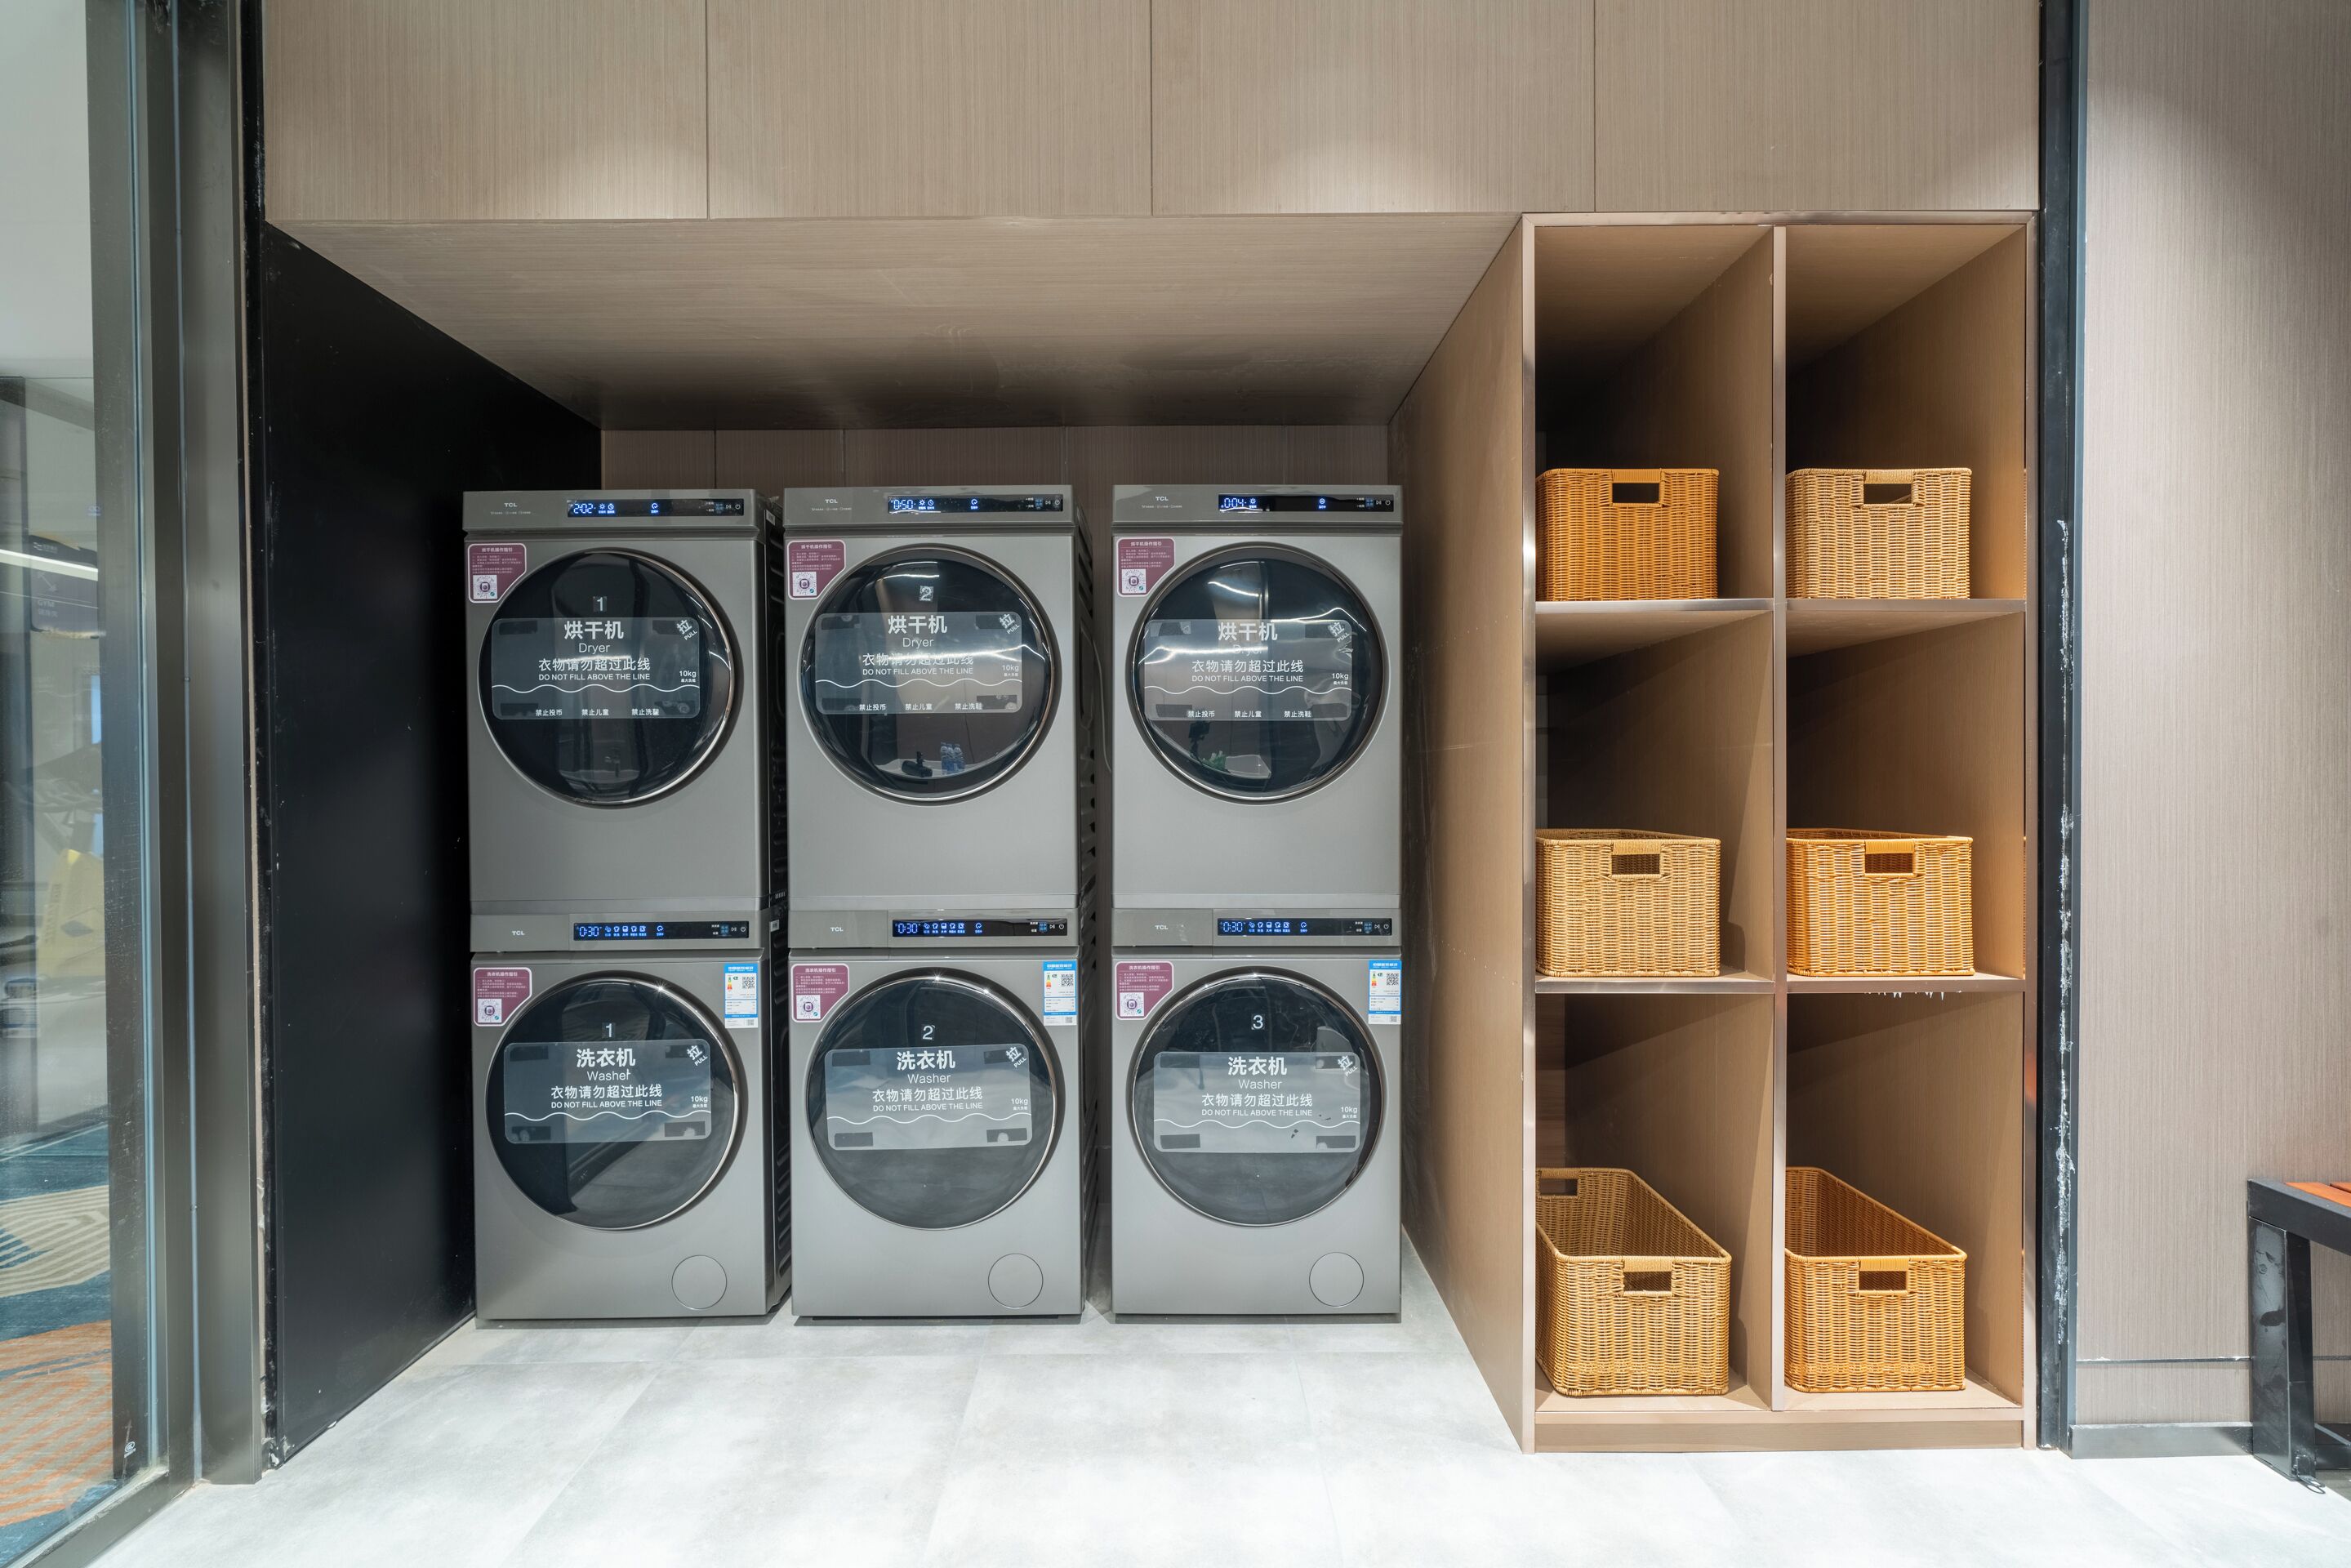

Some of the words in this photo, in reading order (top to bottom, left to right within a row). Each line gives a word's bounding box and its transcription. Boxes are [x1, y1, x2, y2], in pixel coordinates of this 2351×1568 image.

[921, 587, 933, 601] 2
[596, 598, 604, 611] 1
[676, 620, 692, 635] 拉
[888, 615, 948, 635] 烘干机
[999, 614, 1015, 628] 拉
[564, 621, 624, 640] 烘干机
[684, 630, 698, 641] PULL
[1006, 624, 1020, 634] PULL
[1218, 622, 1278, 641] 烘干机
[1329, 622, 1345, 637] 拉
[903, 638, 934, 649] Dryer
[1337, 632, 1350, 643] PULL
[579, 643, 610, 655] Dryer
[539, 657, 650, 671] 衣物请勿超过此线
[1192, 660, 1304, 673] 衣物请勿超过此线
[536, 708, 562, 717] 禁止投币
[1253, 1015, 1264, 1030] 3
[605, 1023, 613, 1038] 1
[922, 1025, 933, 1040] 2
[576, 1048, 636, 1068] 洗衣机
[687, 1045, 703, 1060] 拉
[1005, 1047, 1022, 1062] 拉
[694, 1055, 708, 1067] PULL
[896, 1050, 956, 1071] 洗衣机
[1013, 1056, 1027, 1068] PULL
[1227, 1056, 1287, 1076] 洗衣机
[1338, 1055, 1354, 1070] 拉
[1345, 1065, 1358, 1076] PULL
[907, 1074, 951, 1084] Washer
[1238, 1079, 1282, 1089] Washer
[551, 1084, 663, 1099] 衣物请勿超过此线
[872, 1087, 983, 1102] 衣物请勿超过此线
[1202, 1094, 1313, 1107] 衣物请勿超过此线
[1340, 1106, 1358, 1114] 10kg
